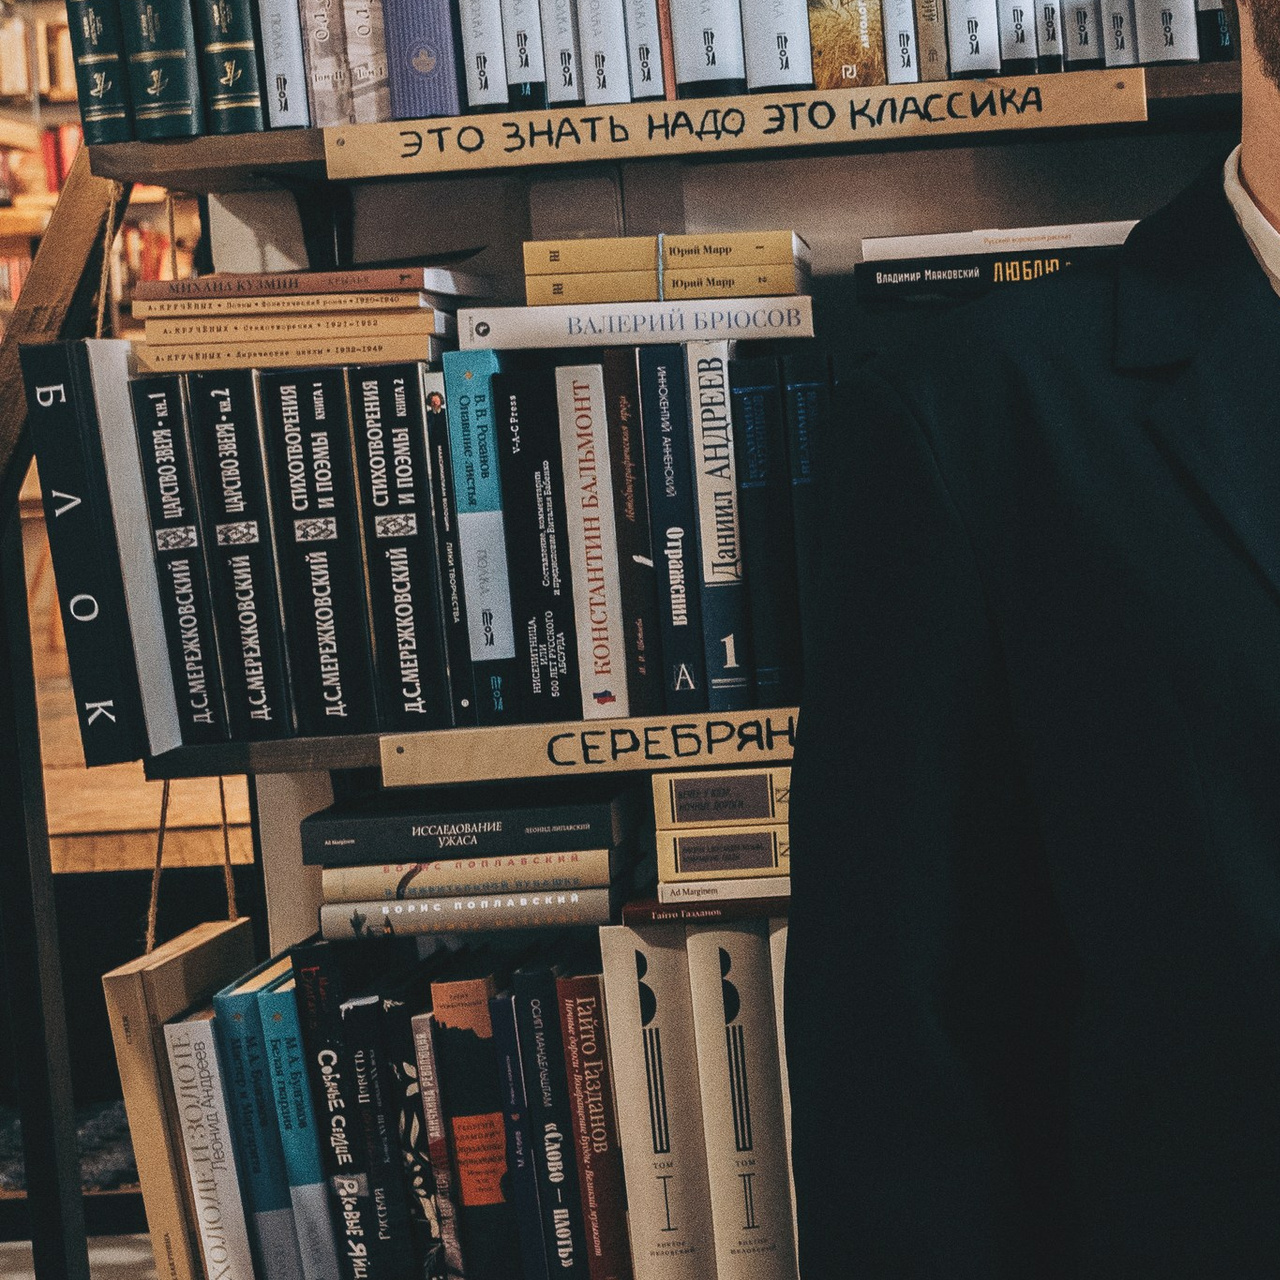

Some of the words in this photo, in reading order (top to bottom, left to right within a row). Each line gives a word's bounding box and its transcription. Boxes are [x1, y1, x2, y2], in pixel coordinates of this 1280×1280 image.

[400, 124, 485, 159] ЭТО
[503, 116, 631, 154] ЗНАТЬ
[647, 109, 746, 142] НАДО
[763, 102, 835, 135] ЭТО
[849, 84, 1044, 133] КЛАССИКА
[566, 311, 687, 338] ВАЛЕРИЙ
[692, 306, 801, 332] БРЮСОВ
[876, 271, 921, 284] Владимир
[924, 267, 980, 281] Маяковский
[279, 385, 309, 512] СТИХОТВОРЕНИЯ
[310, 431, 333, 491] ПОЭМЫ
[361, 380, 390, 508] СТИХОТВОРЕНИЯ
[391, 427, 415, 488] ПОЭМЫ
[572, 380, 599, 513] БАЛЬМОНТ
[698, 357, 734, 481] АНДРЕЕВ
[711, 491, 741, 579] Даниил
[304, 551, 348, 717] Д.С.МЕРЕЖКОВСКИЙ
[384, 547, 428, 713] Д.С.МЕРЕЖКОВСКИЙ
[583, 517, 612, 676] КОНСТАНТИН
[412, 821, 502, 837] ИССЛЕДОВАНИЕ
